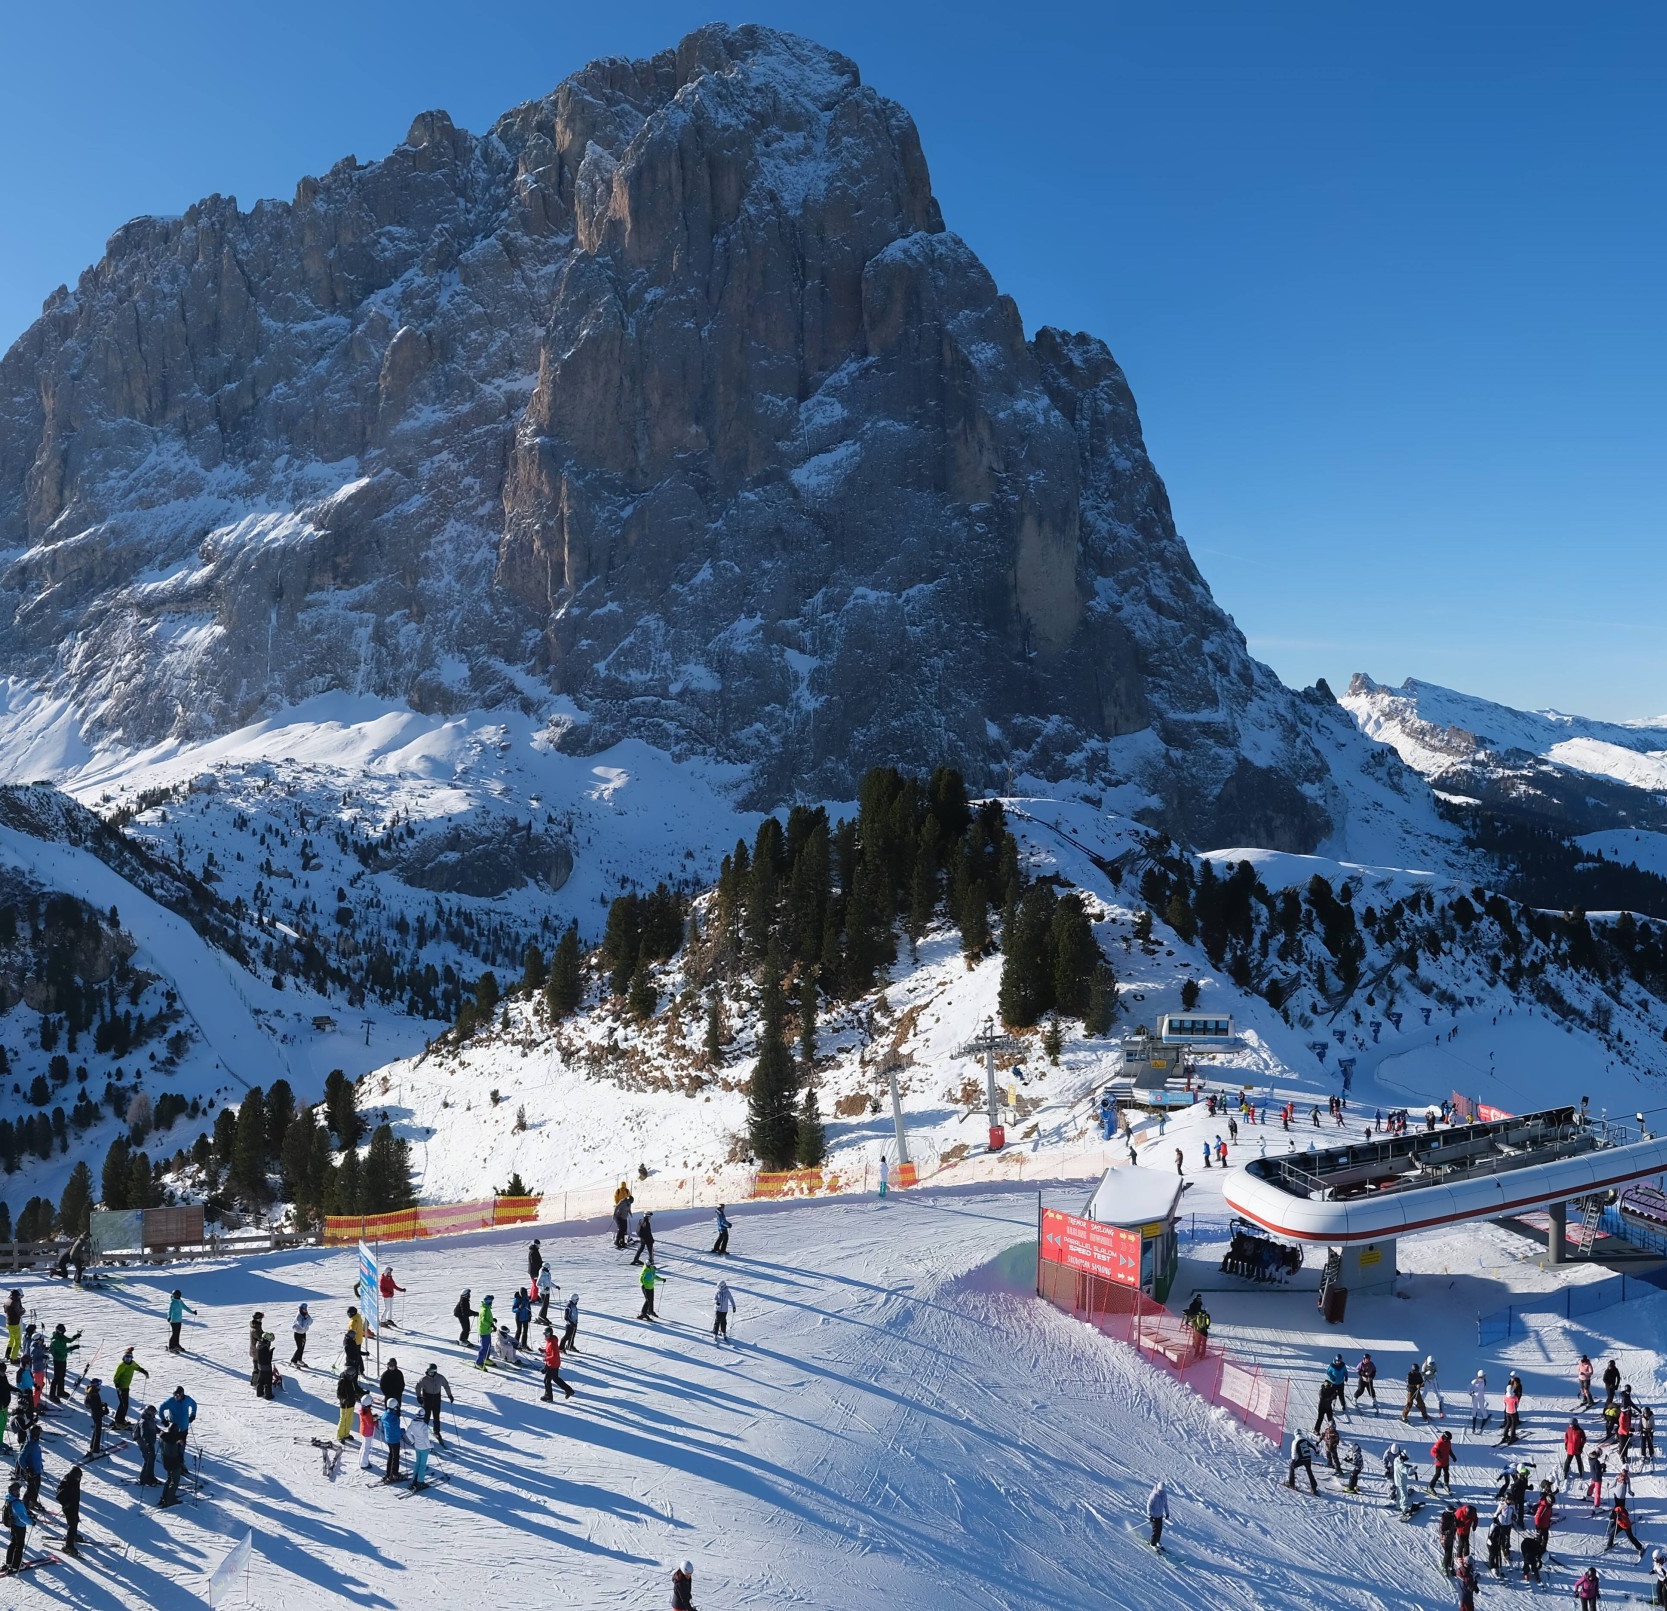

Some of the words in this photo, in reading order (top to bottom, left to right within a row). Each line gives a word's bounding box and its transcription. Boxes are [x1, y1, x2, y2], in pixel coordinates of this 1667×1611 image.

[1063, 1236, 1093, 1250] PARALLEL
[1093, 1245, 1117, 1258] SLALOM
[1068, 1244, 1092, 1257] SPEED
[1093, 1251, 1112, 1263] TEST
